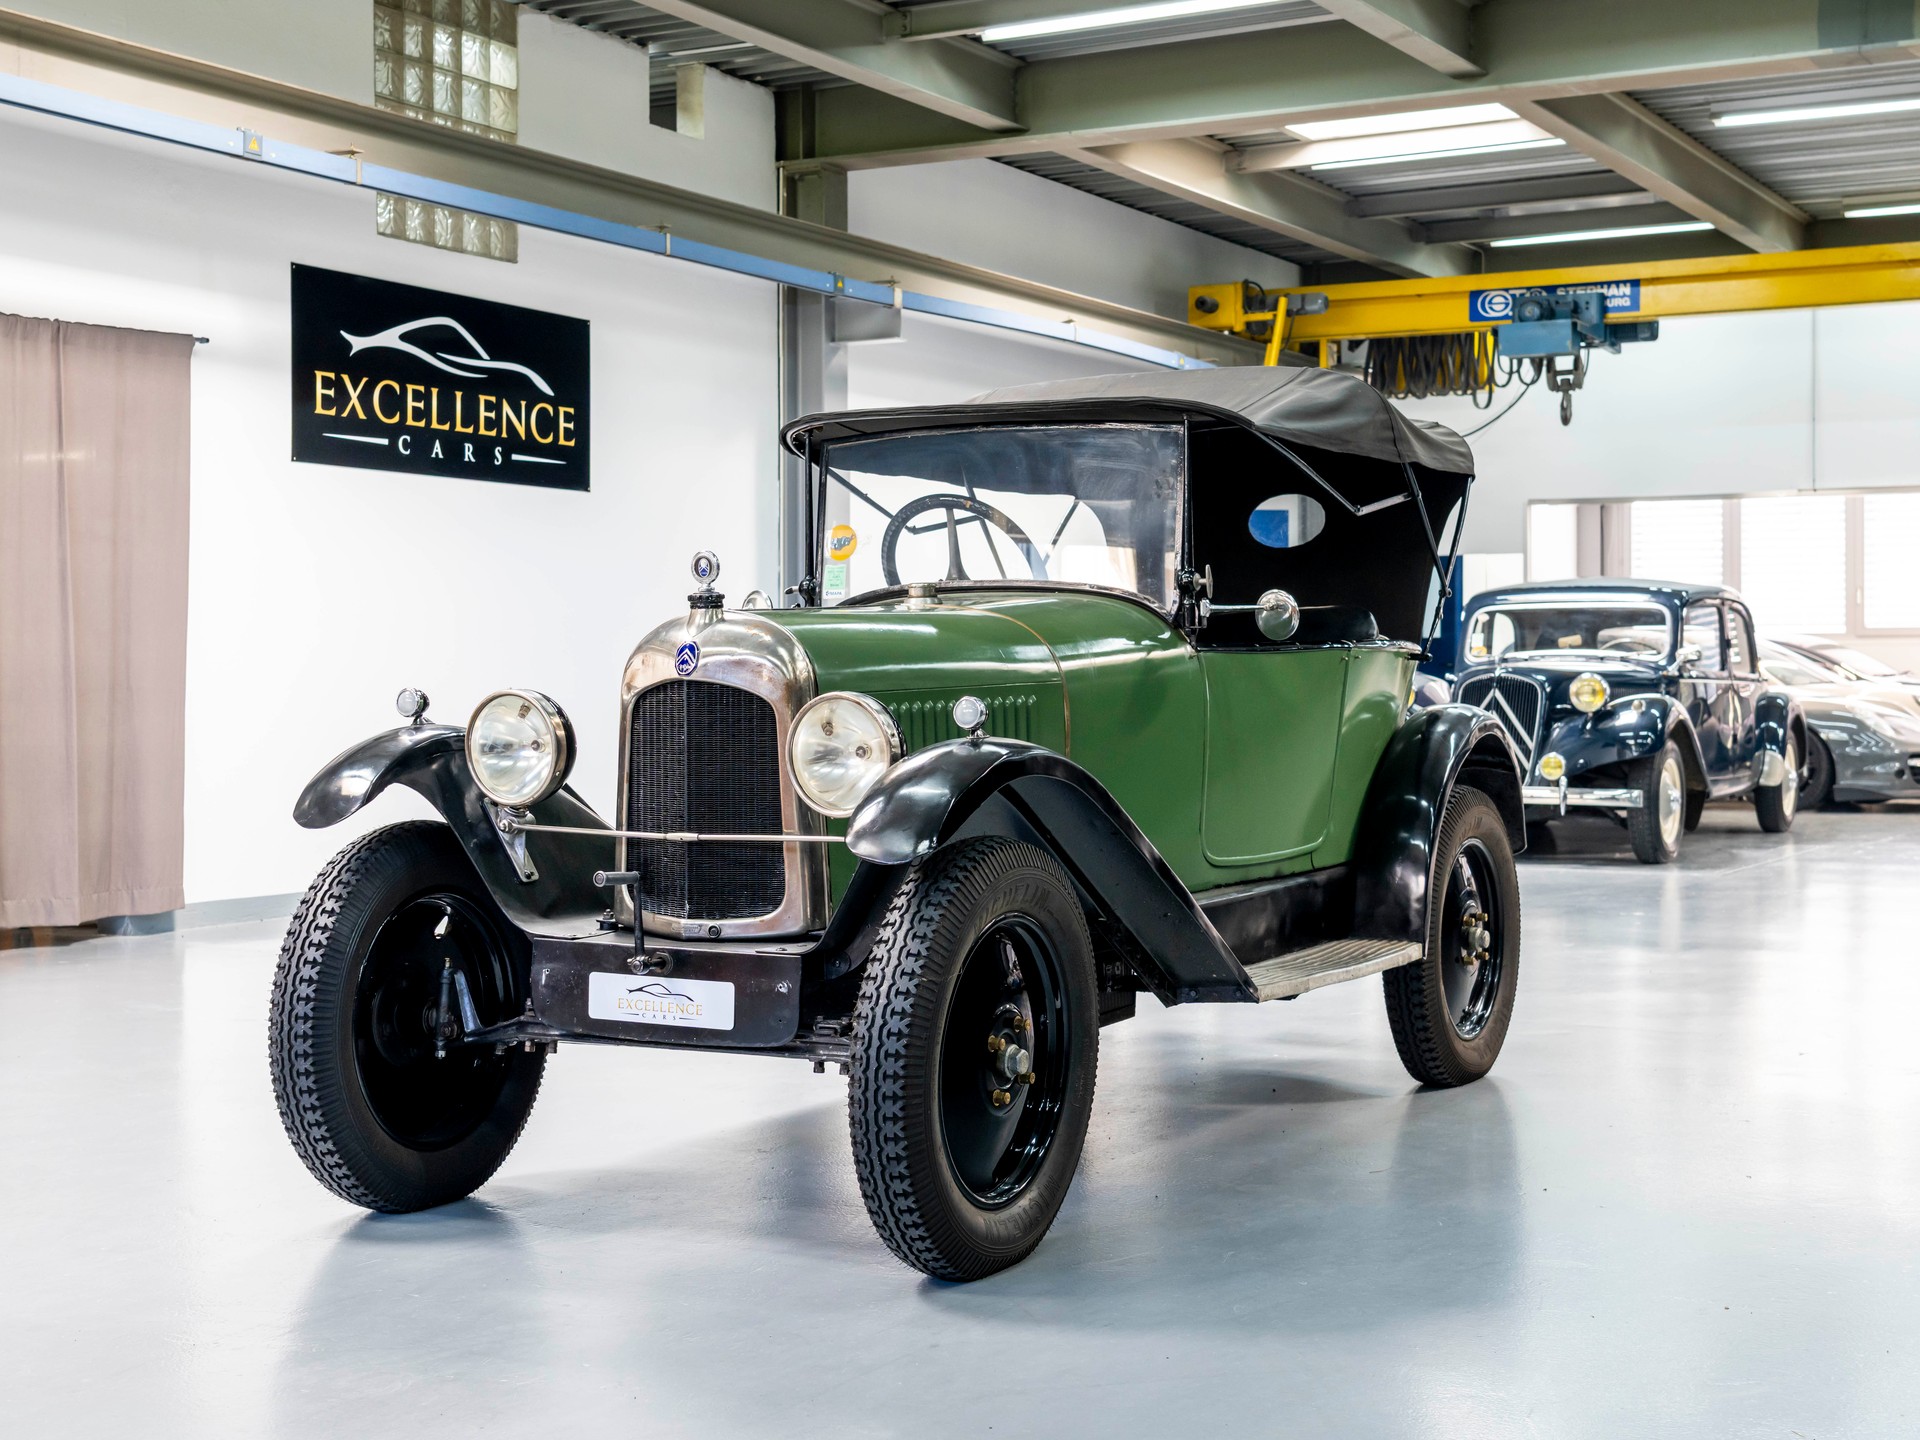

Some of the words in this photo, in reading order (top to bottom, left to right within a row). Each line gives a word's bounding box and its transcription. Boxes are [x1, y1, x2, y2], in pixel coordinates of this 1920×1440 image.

[1605, 297, 1631, 307] URG
[314, 370, 576, 447] EXCELLENCE
[398, 435, 502, 465] CARS
[617, 998, 703, 1016] EXCELLENCE
[642, 1012, 676, 1021] CARS
